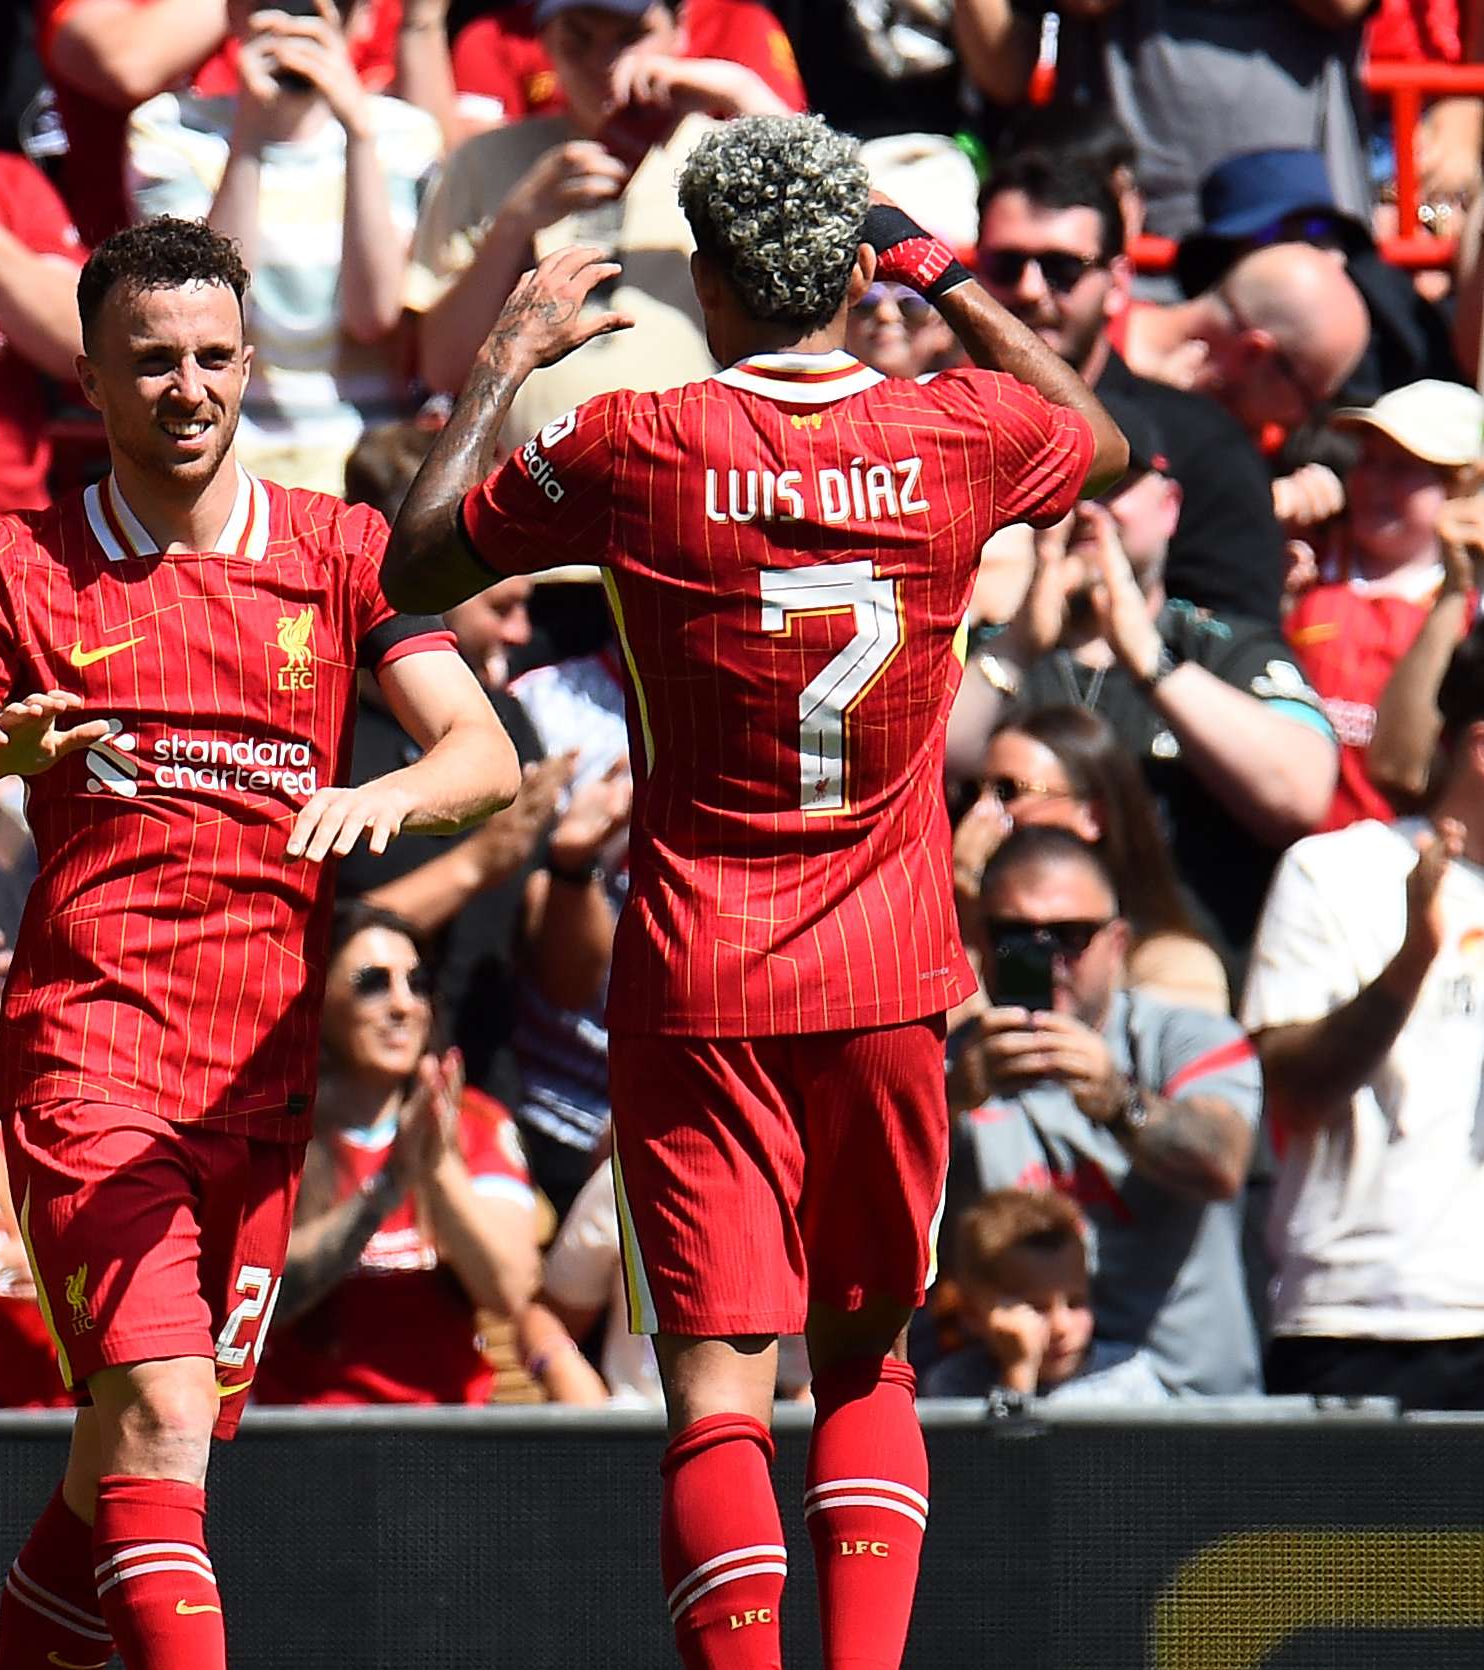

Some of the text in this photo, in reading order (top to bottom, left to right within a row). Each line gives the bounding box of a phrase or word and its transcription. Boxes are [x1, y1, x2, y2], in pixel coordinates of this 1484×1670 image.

[706, 456, 930, 524] LUIS DÍAZ
[760, 560, 905, 817] 7
[153, 733, 312, 767] standard
[154, 762, 316, 797] chartered
[840, 1540, 890, 1558] LFC
[729, 1608, 773, 1631] LFC
